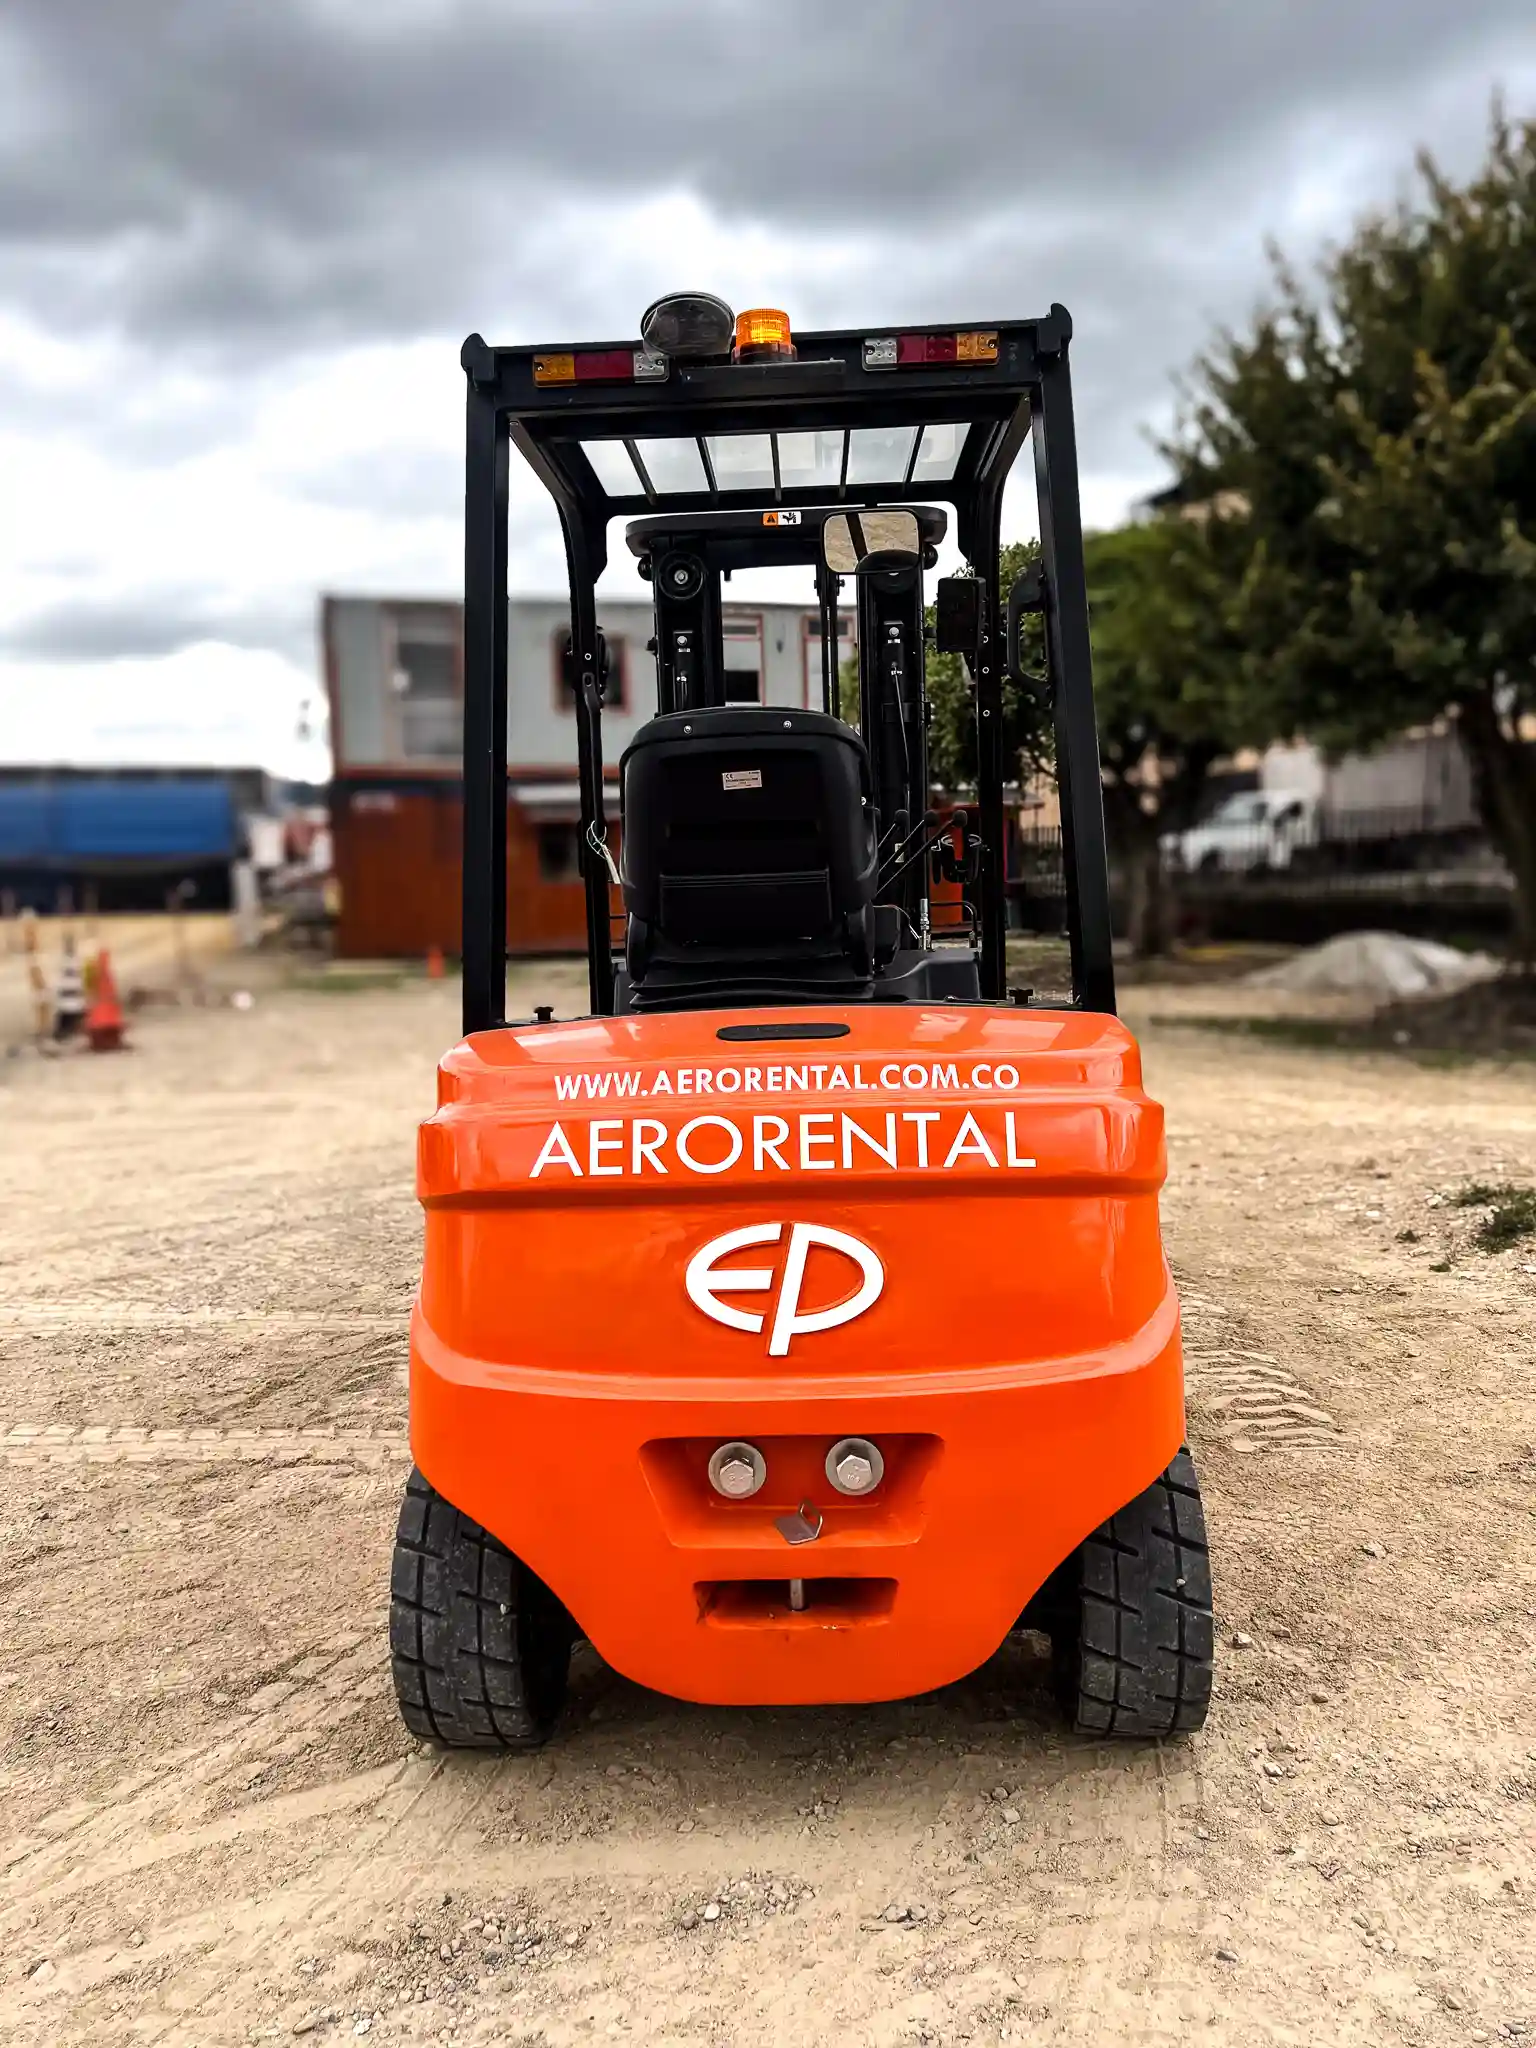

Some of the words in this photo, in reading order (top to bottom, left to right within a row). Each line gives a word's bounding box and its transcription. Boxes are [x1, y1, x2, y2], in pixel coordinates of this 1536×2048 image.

[554, 1063, 1020, 1101] WWW.AERORENTAL.COM.CO
[529, 1111, 1037, 1178] AERORENTAL
[685, 1222, 884, 1356] EP
